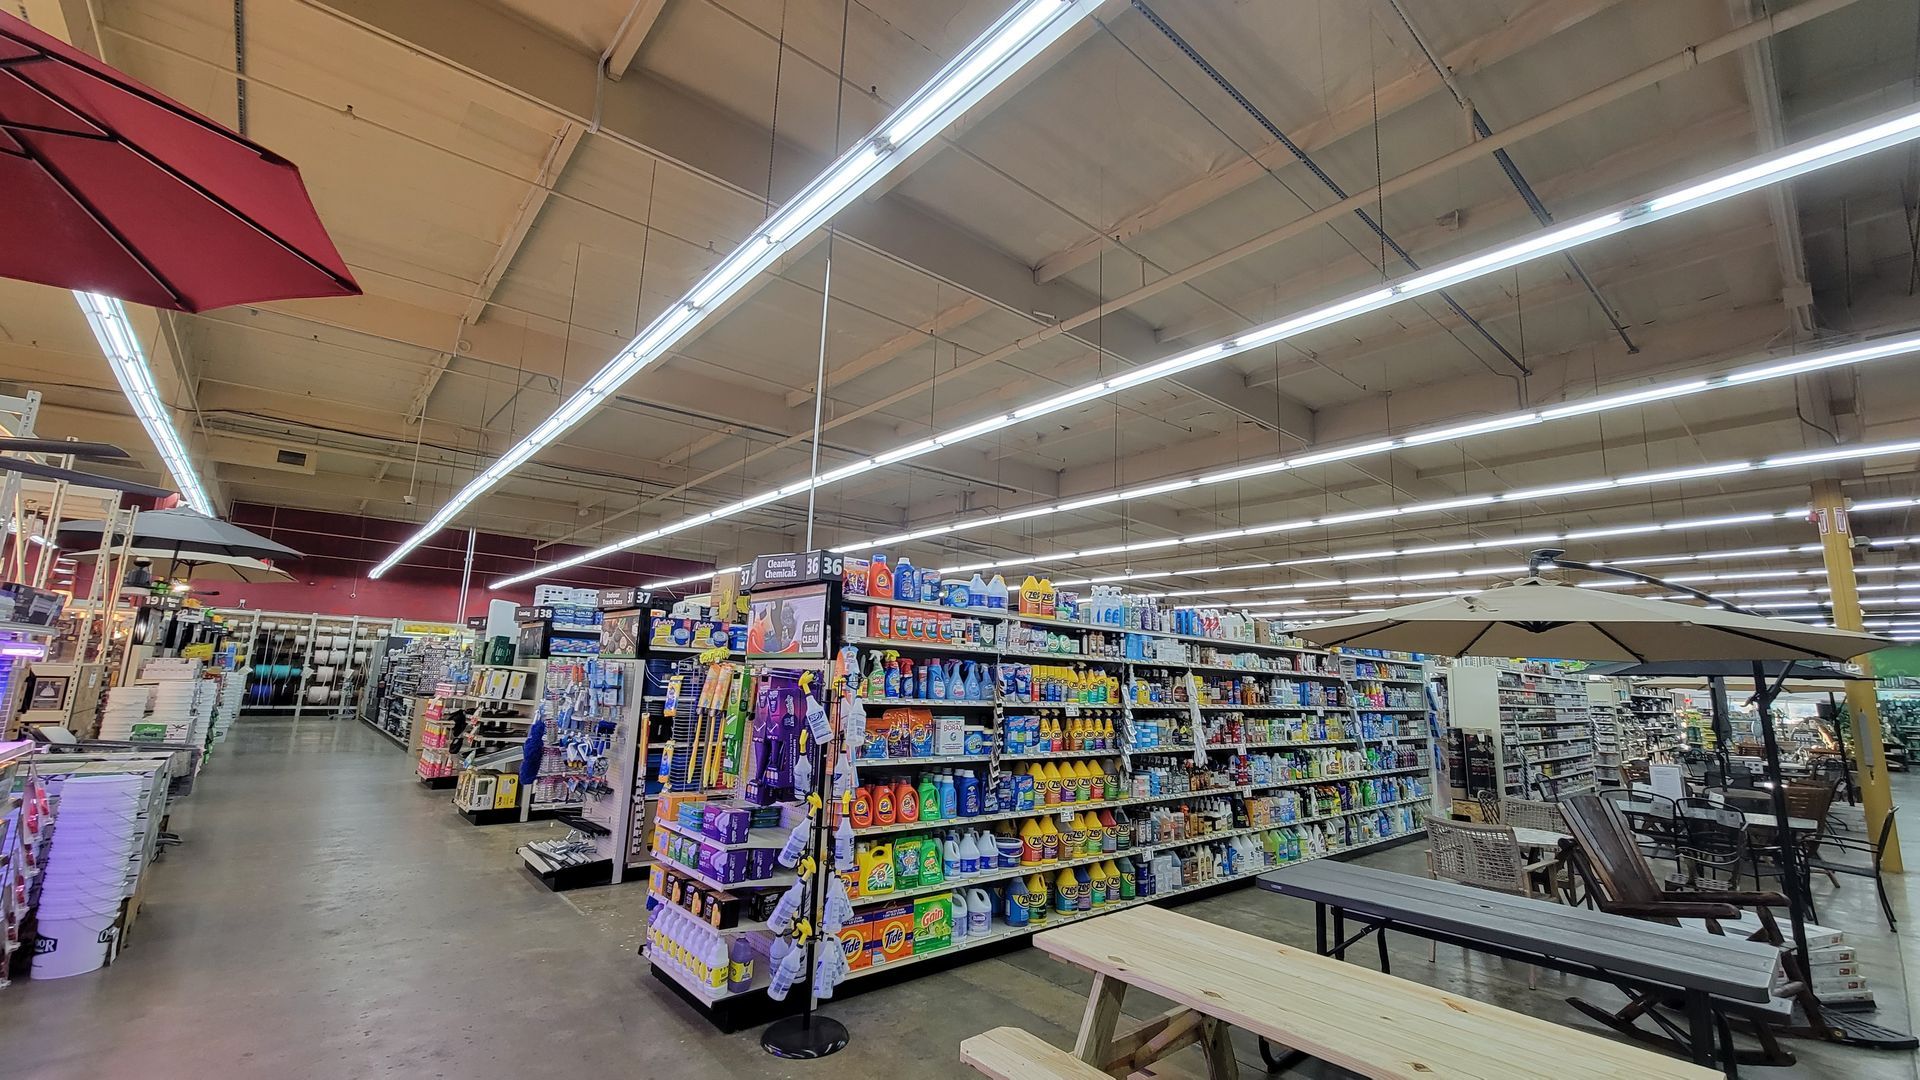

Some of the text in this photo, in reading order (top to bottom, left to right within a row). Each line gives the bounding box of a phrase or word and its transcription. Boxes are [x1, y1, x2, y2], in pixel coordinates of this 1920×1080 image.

[767, 558, 796, 568] Cleaning
[806, 557, 819, 575] 36
[823, 556, 843, 576] 36
[740, 570, 750, 585] 37
[764, 569, 798, 579] Chemicals
[145, 596, 159, 604] 19
[636, 592, 651, 604] 37
[540, 608, 552, 618] 38
[802, 635, 818, 644] CLEAN
[921, 907, 944, 928] Gain
[886, 928, 904, 950] Tide
[841, 938, 861, 955] Tide
